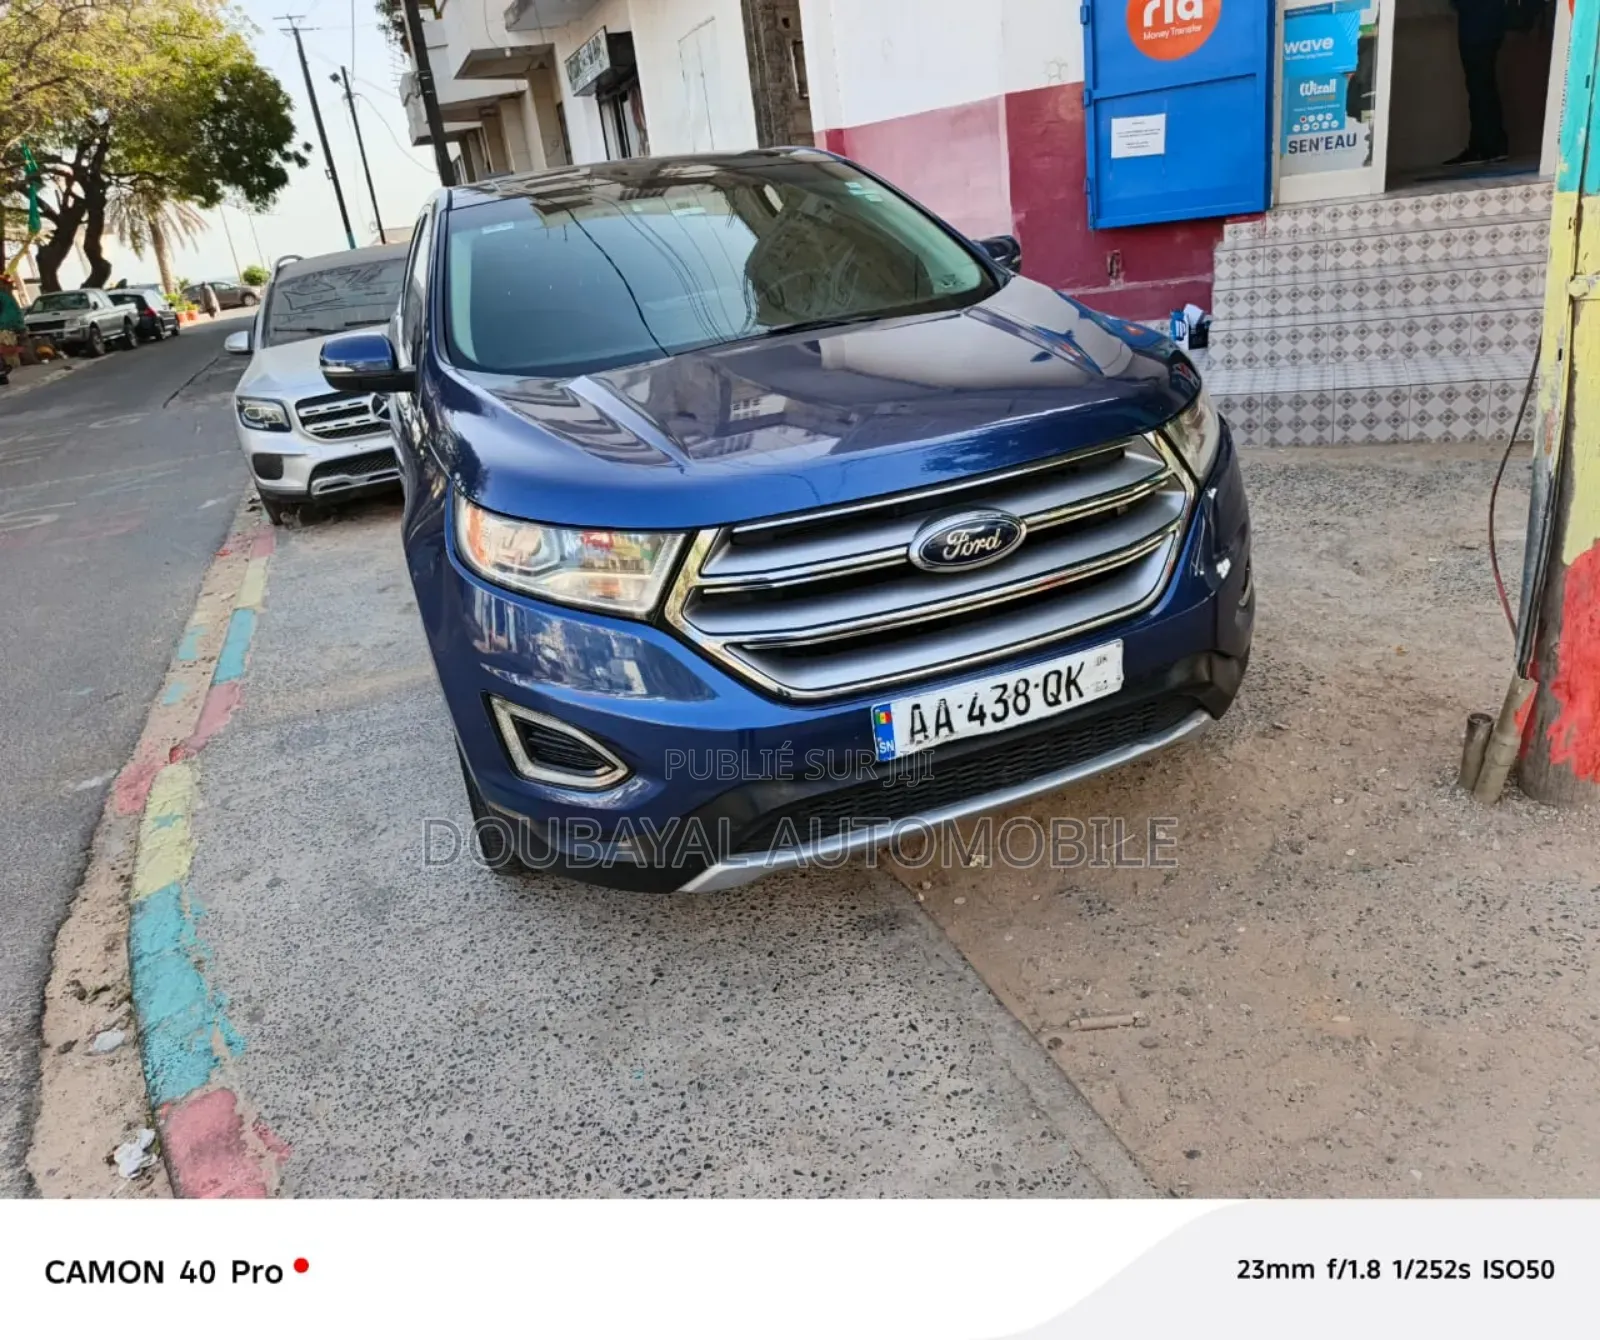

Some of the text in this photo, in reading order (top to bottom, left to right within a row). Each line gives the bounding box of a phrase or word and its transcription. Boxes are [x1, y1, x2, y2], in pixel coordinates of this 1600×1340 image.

[1143, 24, 1202, 41] Money Transfer
[1284, 37, 1334, 55] wave
[1288, 133, 1357, 155] SEN'EAU
[942, 526, 1003, 561] Ford
[879, 740, 895, 754] SN
